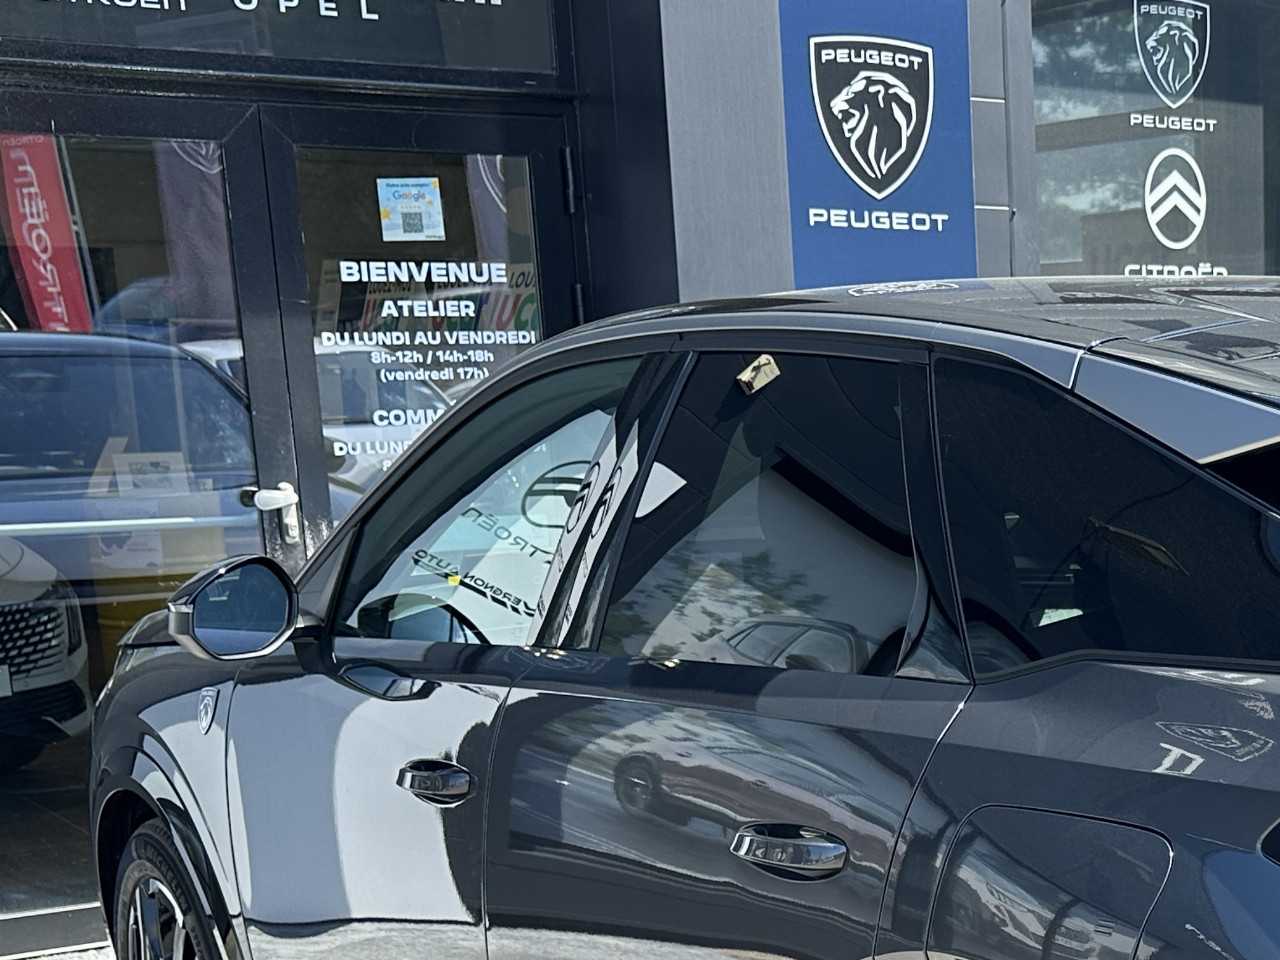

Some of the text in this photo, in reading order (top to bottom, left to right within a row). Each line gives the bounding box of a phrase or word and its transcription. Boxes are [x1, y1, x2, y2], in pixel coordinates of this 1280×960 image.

[1140, 4, 1204, 20] PEUGEOT
[821, 48, 923, 70] PEUGEOT
[1130, 113, 1218, 132] PEUGEOT
[392, 190, 426, 202] Google
[809, 207, 949, 231] PEUGEOT
[339, 260, 508, 283] BIENVENUE
[380, 299, 476, 318] ATELIER
[321, 330, 536, 346] DU LUNDI AU VENDREDI
[370, 350, 494, 365] 8h-12h / 14h-18h
[379, 367, 490, 383] (vendredi 17h)
[333, 441, 361, 457] DU
